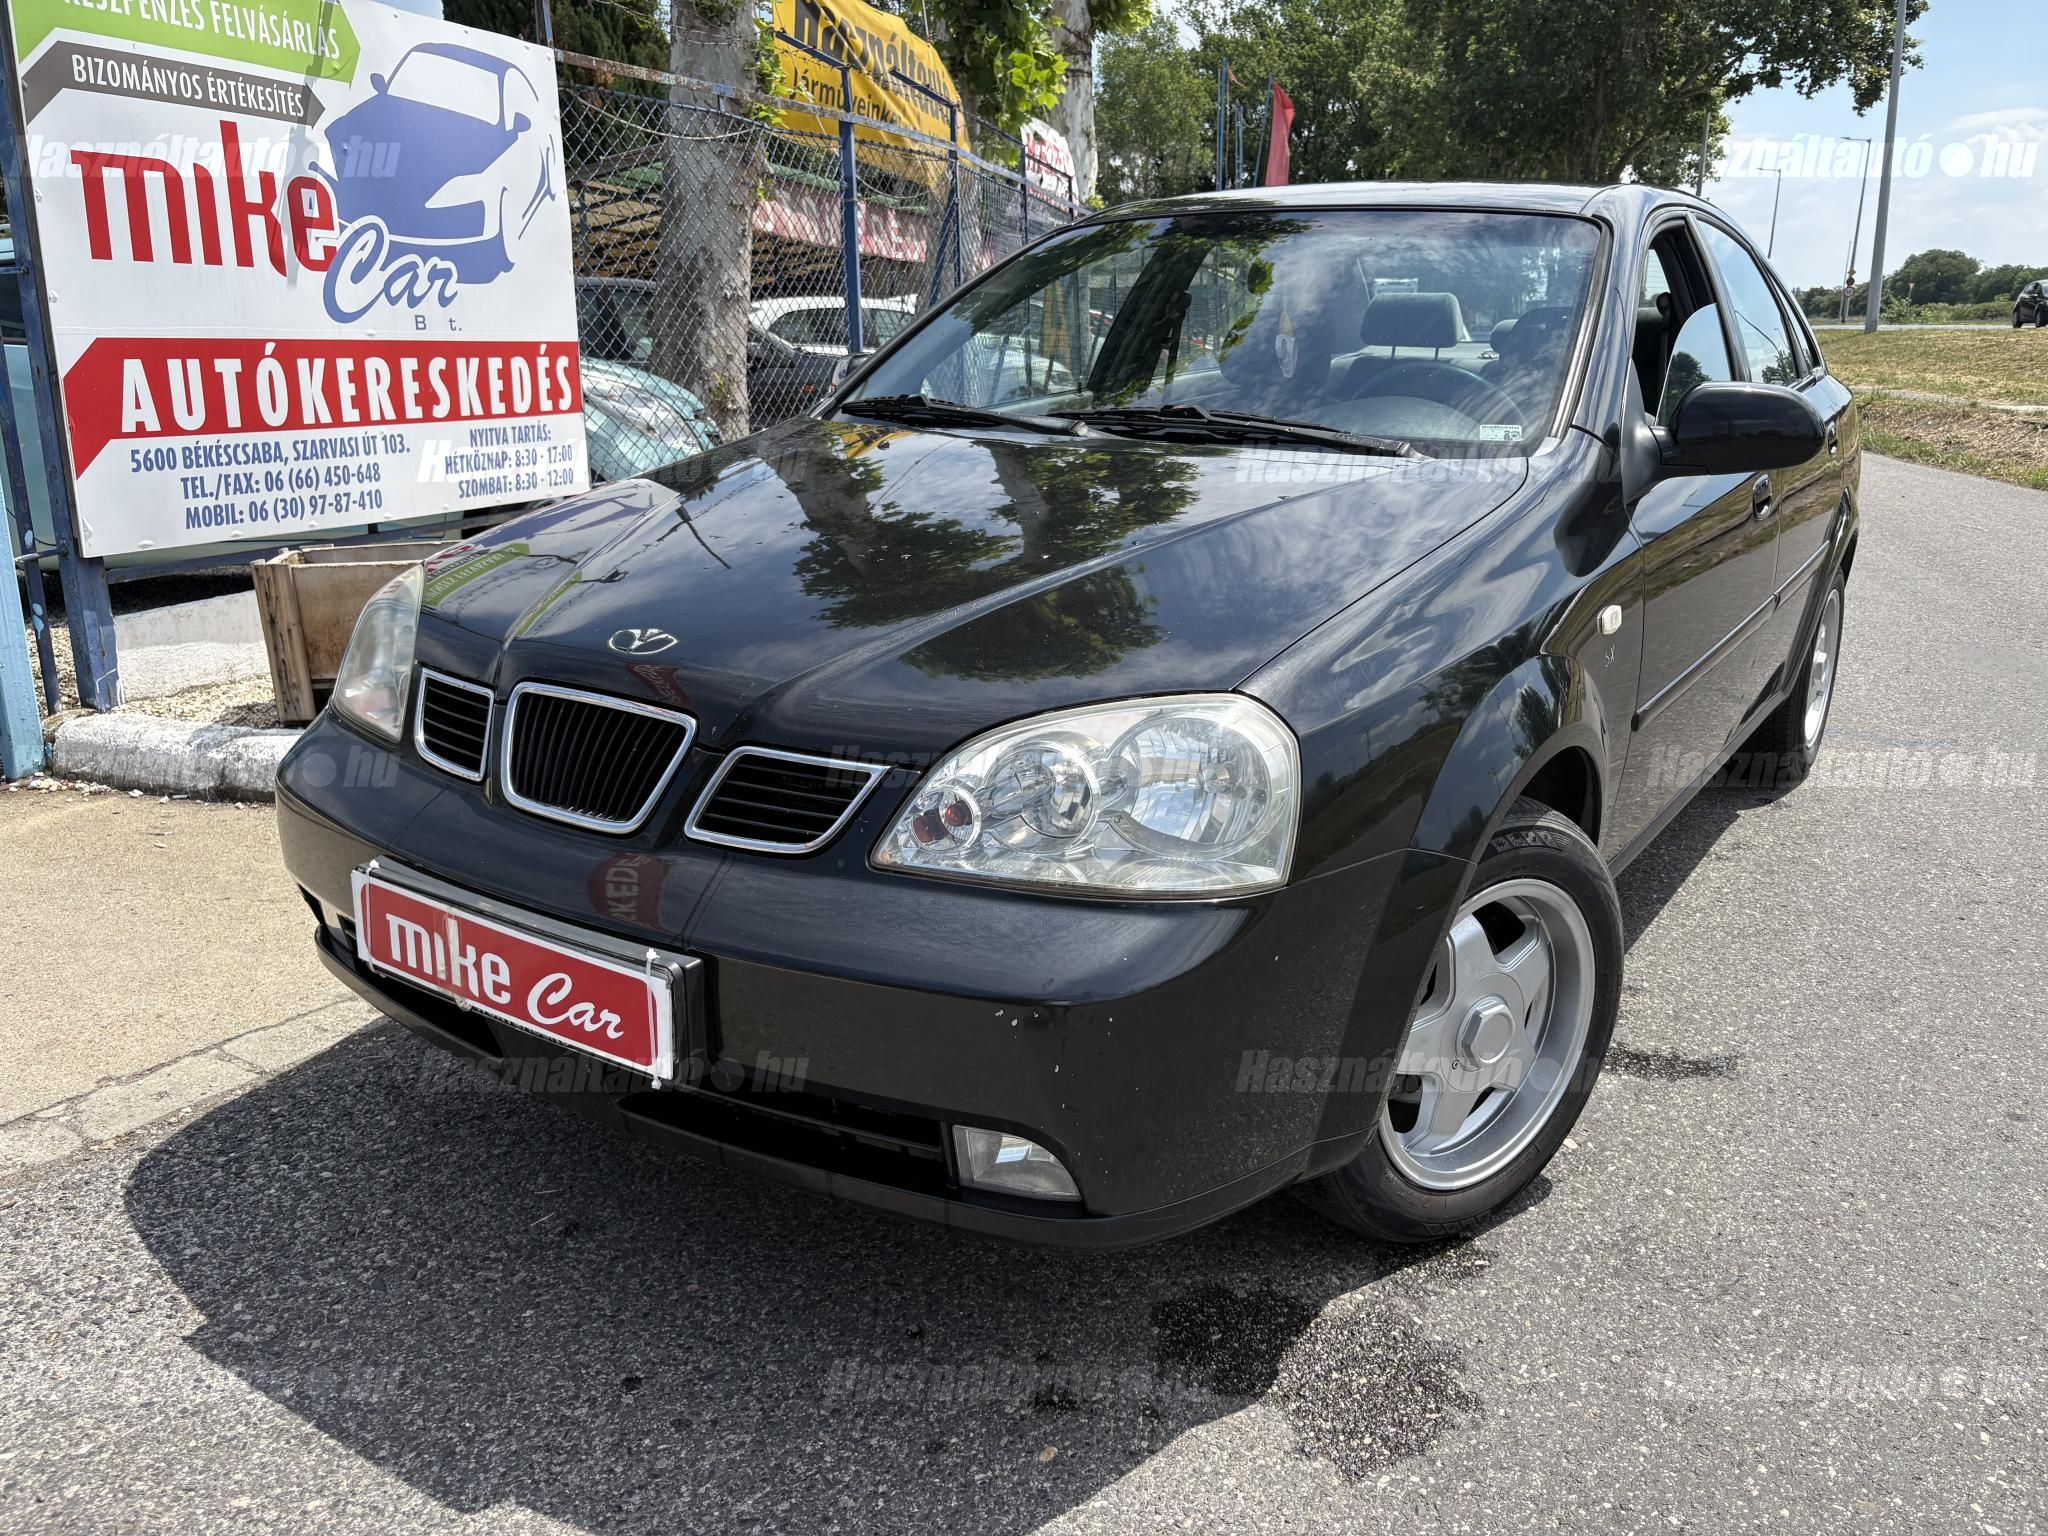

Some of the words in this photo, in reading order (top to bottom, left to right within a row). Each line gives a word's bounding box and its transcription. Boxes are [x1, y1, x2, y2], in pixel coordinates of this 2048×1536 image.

[211, 0, 341, 60] FELVÁSÁRLÁS
[208, 71, 305, 118] ÉRTÉKESÍTÉS
[70, 119, 339, 278] mike
[323, 221, 458, 324] Car
[120, 341, 572, 433] AUTÓKERESKEDÉS
[130, 446, 178, 473] 5600
[182, 439, 290, 470] BÉKÉSCSABA,
[293, 438, 360, 462] SZARVASI
[363, 430, 378, 456] ÚT
[381, 432, 411, 455] 103.
[469, 425, 509, 449] NYITVA
[511, 419, 552, 445] TARTÁS:
[180, 471, 261, 501] TEL./FAX:
[264, 469, 283, 492] 06
[288, 465, 320, 492] (66)
[324, 461, 381, 487] 450-648
[445, 449, 512, 476] HÉTKÖZNAP:
[515, 449, 538, 468] 8:30
[547, 444, 573, 464] 17:00
[458, 475, 513, 499] SZOMBAT:
[515, 471, 538, 492] 8:30
[547, 467, 574, 487] 12:00
[185, 501, 245, 530] MOBIL:
[249, 500, 268, 523] 06
[273, 494, 306, 524] (30)
[309, 488, 383, 516] 97-87-410
[385, 912, 512, 1005] mike
[526, 972, 625, 1040] Car
